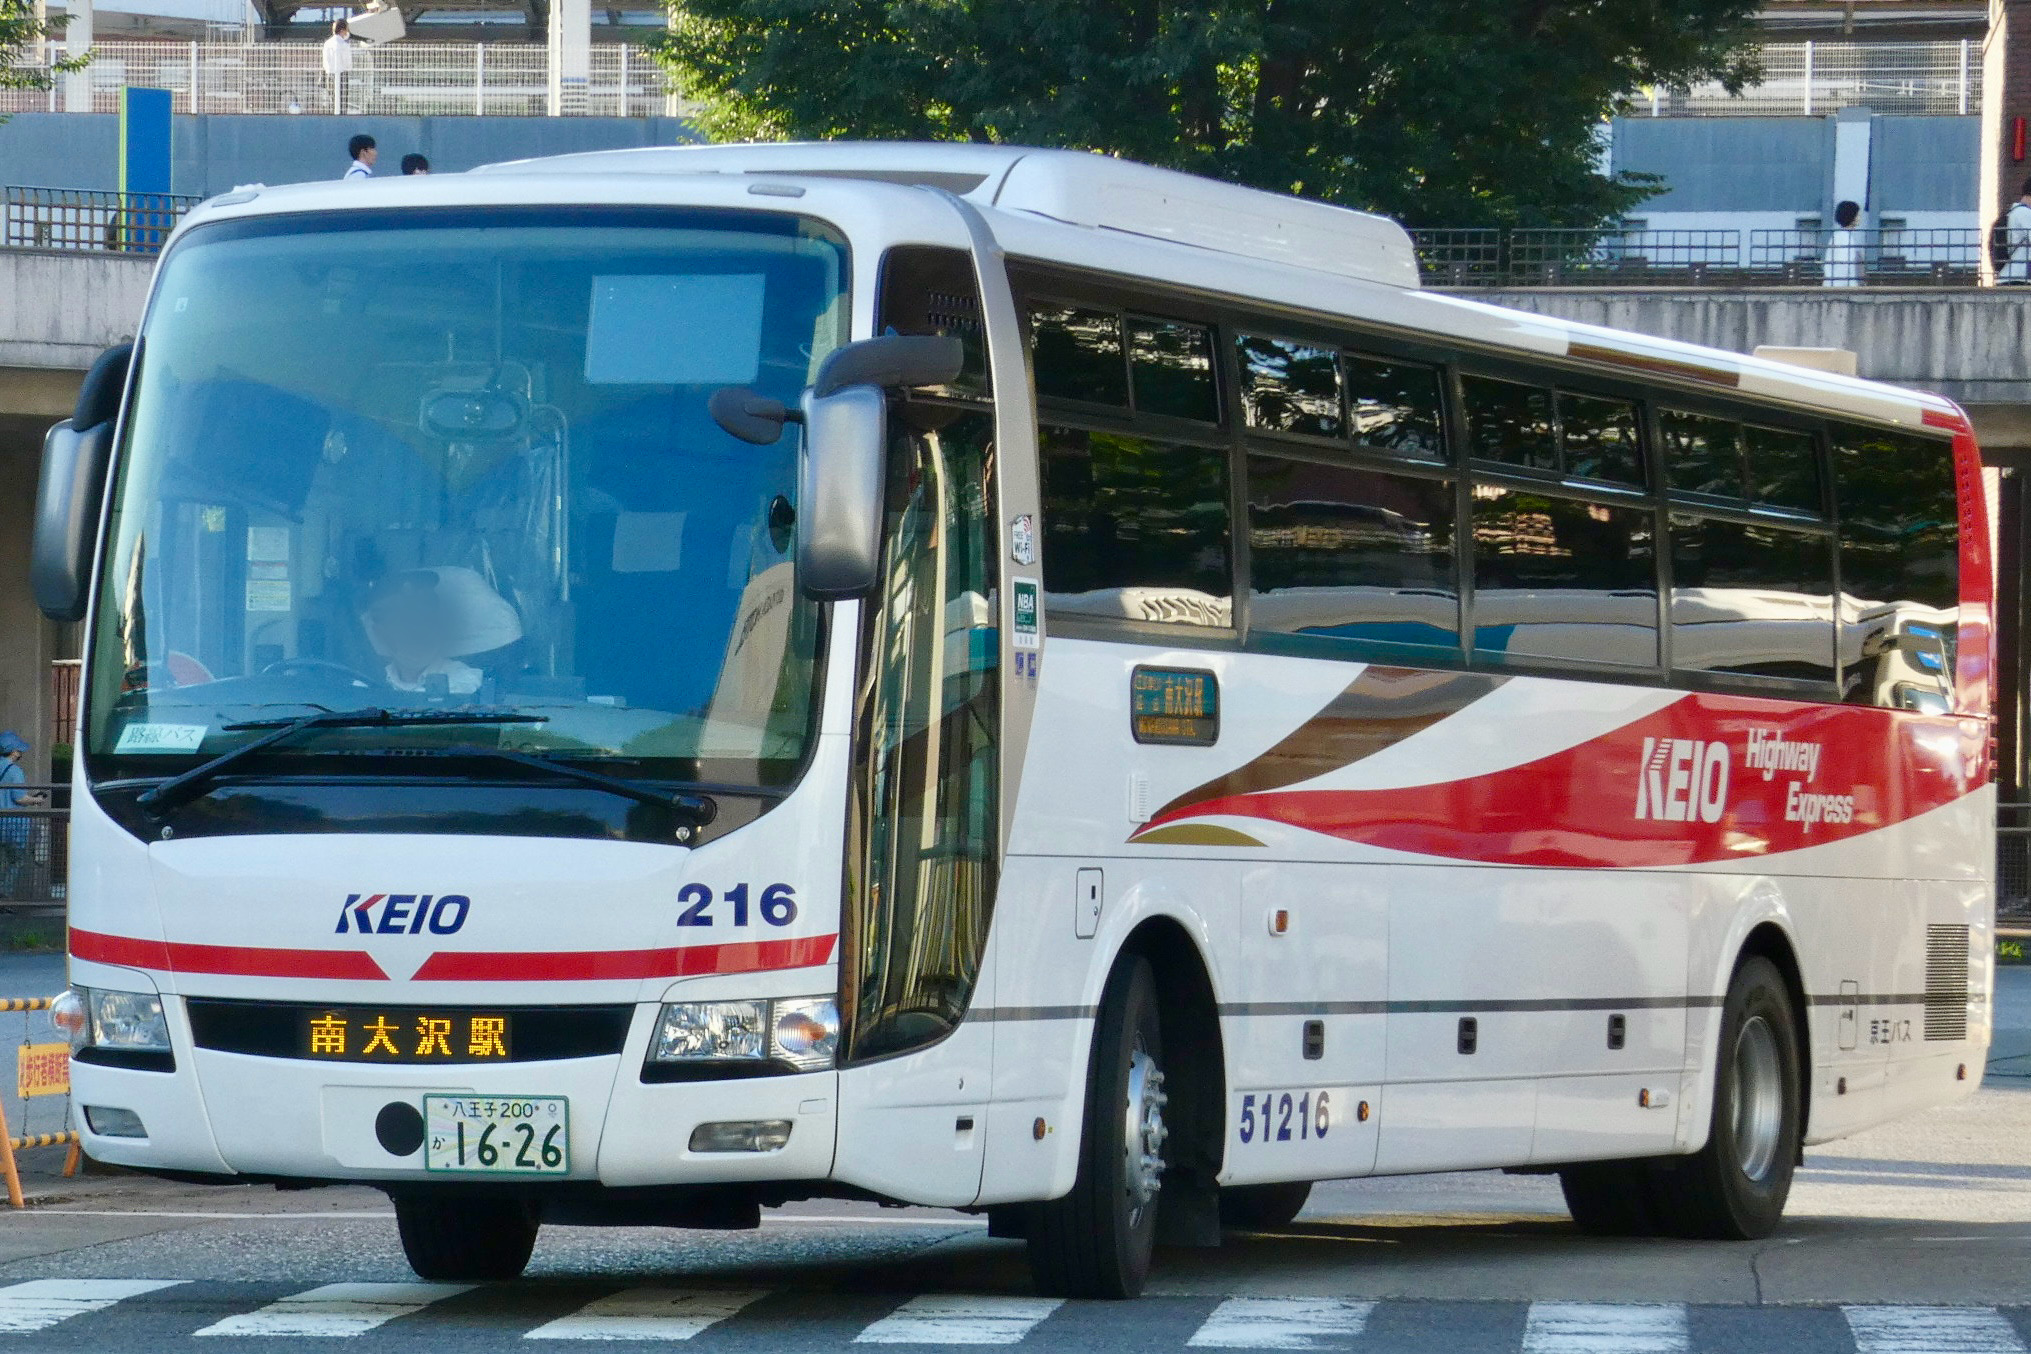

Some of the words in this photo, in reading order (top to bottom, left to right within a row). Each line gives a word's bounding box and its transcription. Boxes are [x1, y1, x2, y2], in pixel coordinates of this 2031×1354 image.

[1017, 593, 1034, 610] NBA
[126, 726, 195, 744] 路線バス
[1745, 728, 1821, 783] Highway
[1635, 736, 1729, 824] KEIO
[1785, 781, 1854, 834] Express
[335, 894, 471, 935] KEIO
[676, 882, 798, 927] 216
[310, 1015, 506, 1056] 南大沢駅
[1870, 1018, 1912, 1044] 京王バス
[1240, 1090, 1330, 1144] 51216
[432, 1136, 446, 1150] か
[457, 1121, 563, 1168] 16-26
